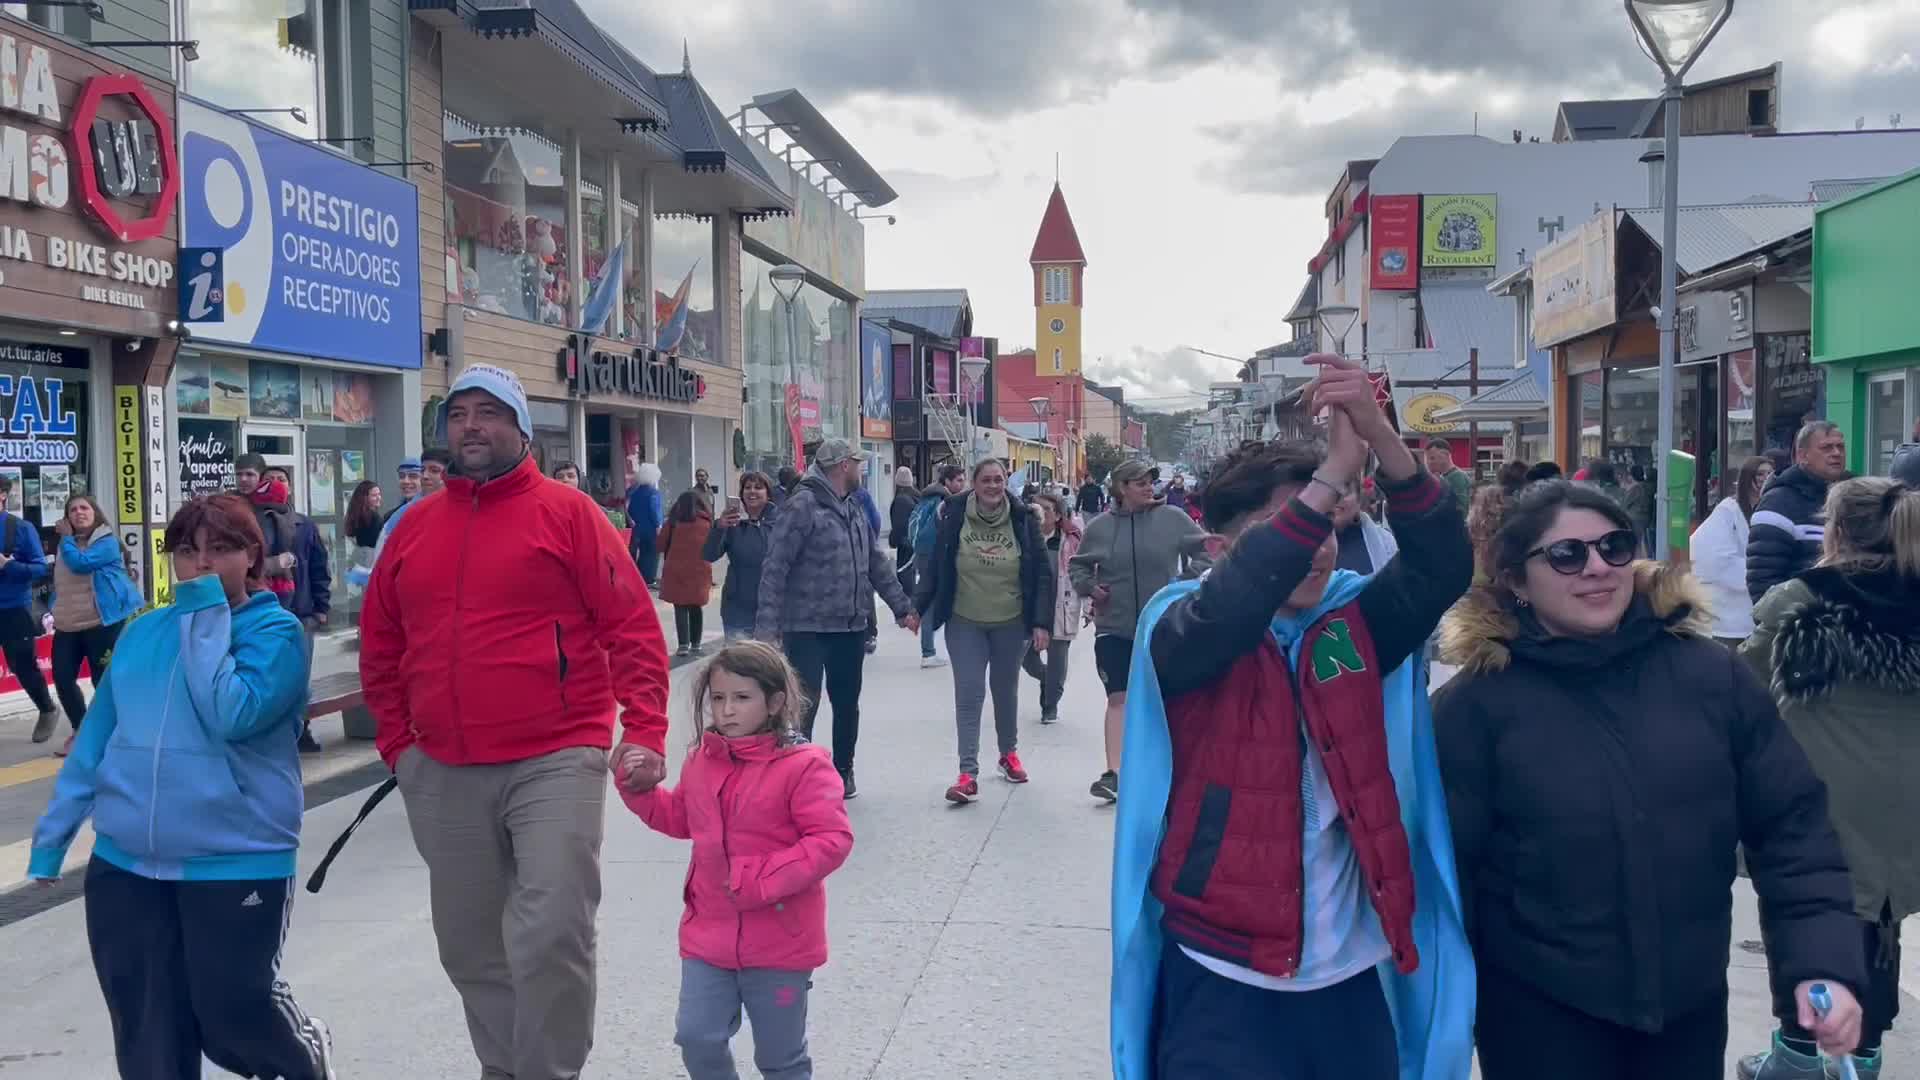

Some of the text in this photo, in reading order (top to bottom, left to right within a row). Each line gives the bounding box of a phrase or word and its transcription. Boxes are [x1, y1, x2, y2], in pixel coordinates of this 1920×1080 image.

[281, 180, 399, 248] PRESTIGIO
[48, 237, 108, 276] BIKE
[112, 251, 173, 289] SHOP
[281, 233, 401, 287] OPERADORES
[1427, 255, 1493, 265] RESTAURANT
[83, 286, 145, 308] BIKE RENTAL
[283, 275, 391, 324] RECEPTIVOS
[575, 334, 699, 403] Karukinka
[120, 396, 136, 514] BICI TOURS
[151, 394, 162, 516] RENTAL
[963, 532, 1014, 550] HOLLISTER
[1311, 618, 1366, 683] N
